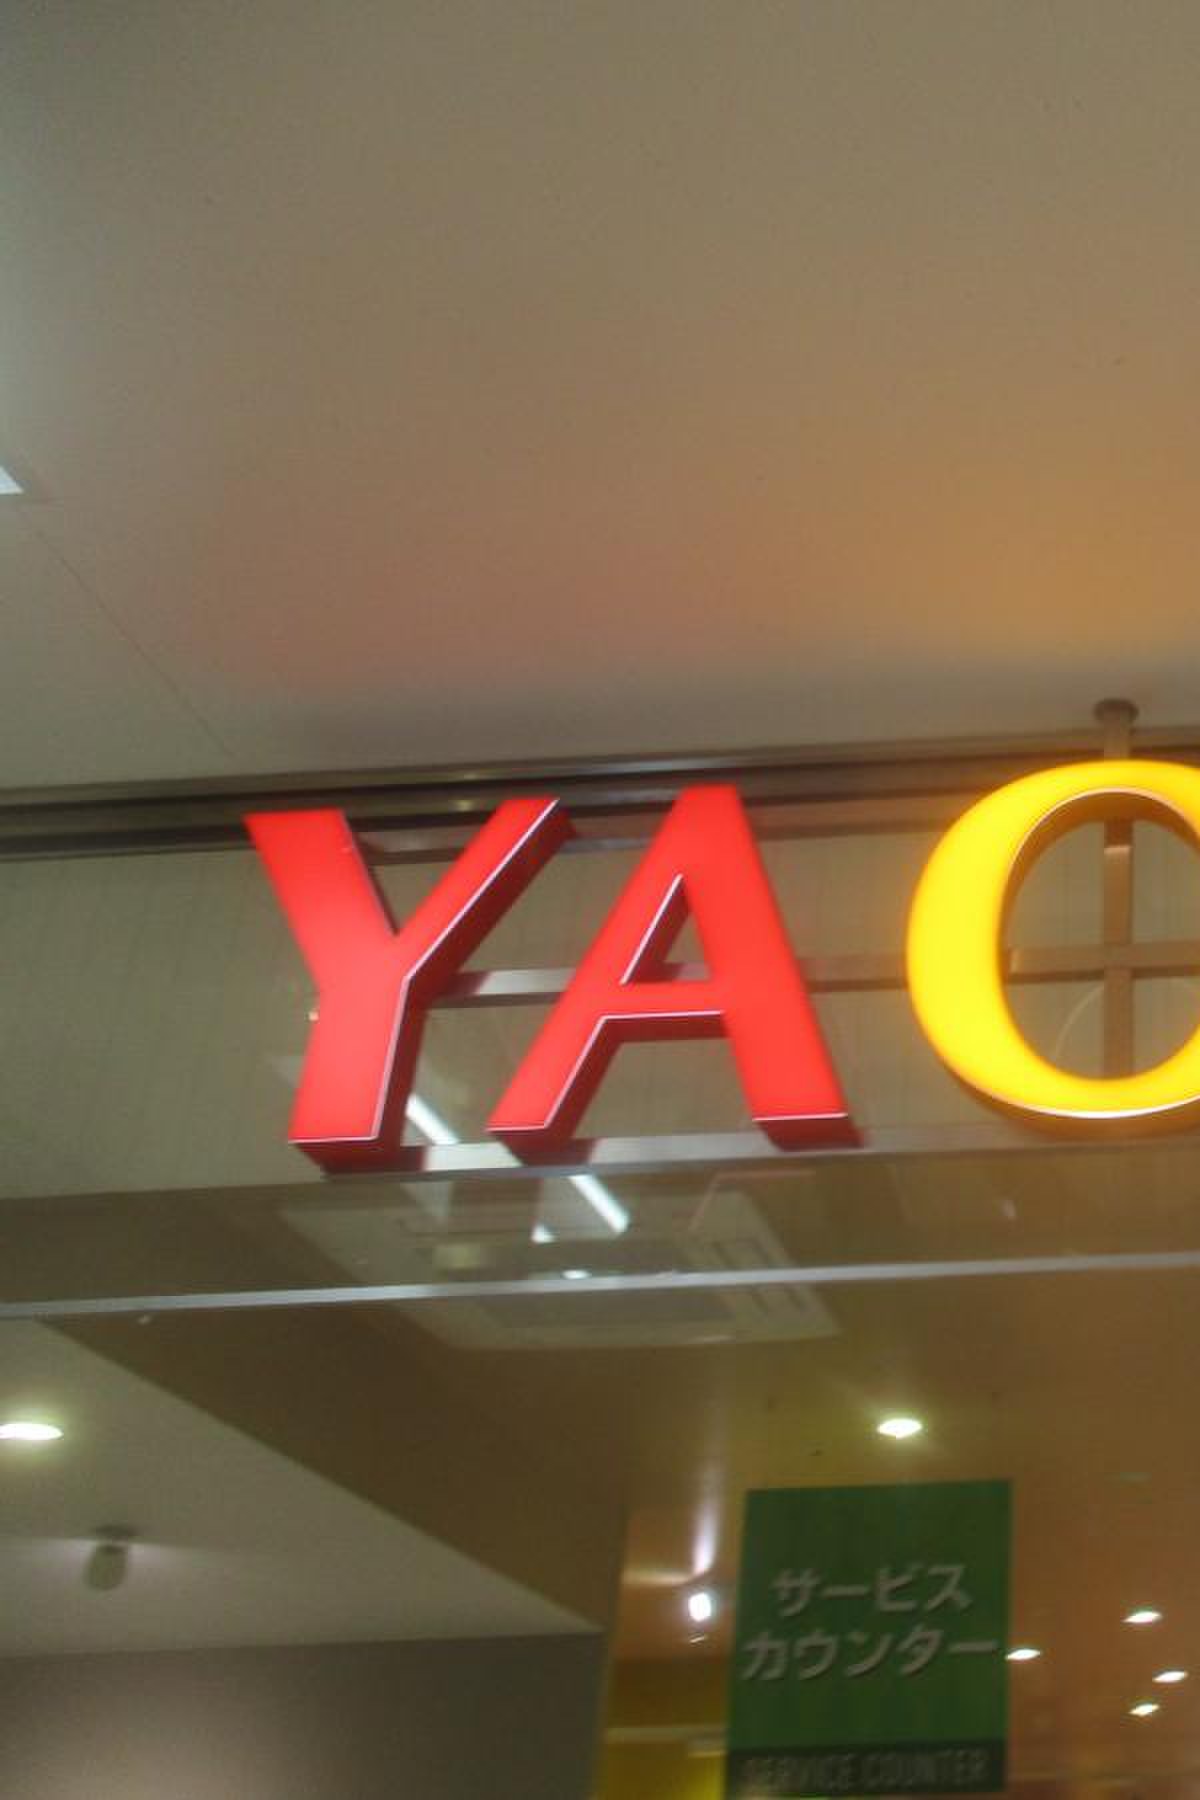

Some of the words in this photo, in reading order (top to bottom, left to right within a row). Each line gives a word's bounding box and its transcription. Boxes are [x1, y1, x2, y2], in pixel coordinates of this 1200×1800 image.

[773, 1562, 972, 1616] サービス
[742, 1624, 998, 1681] カウンター
